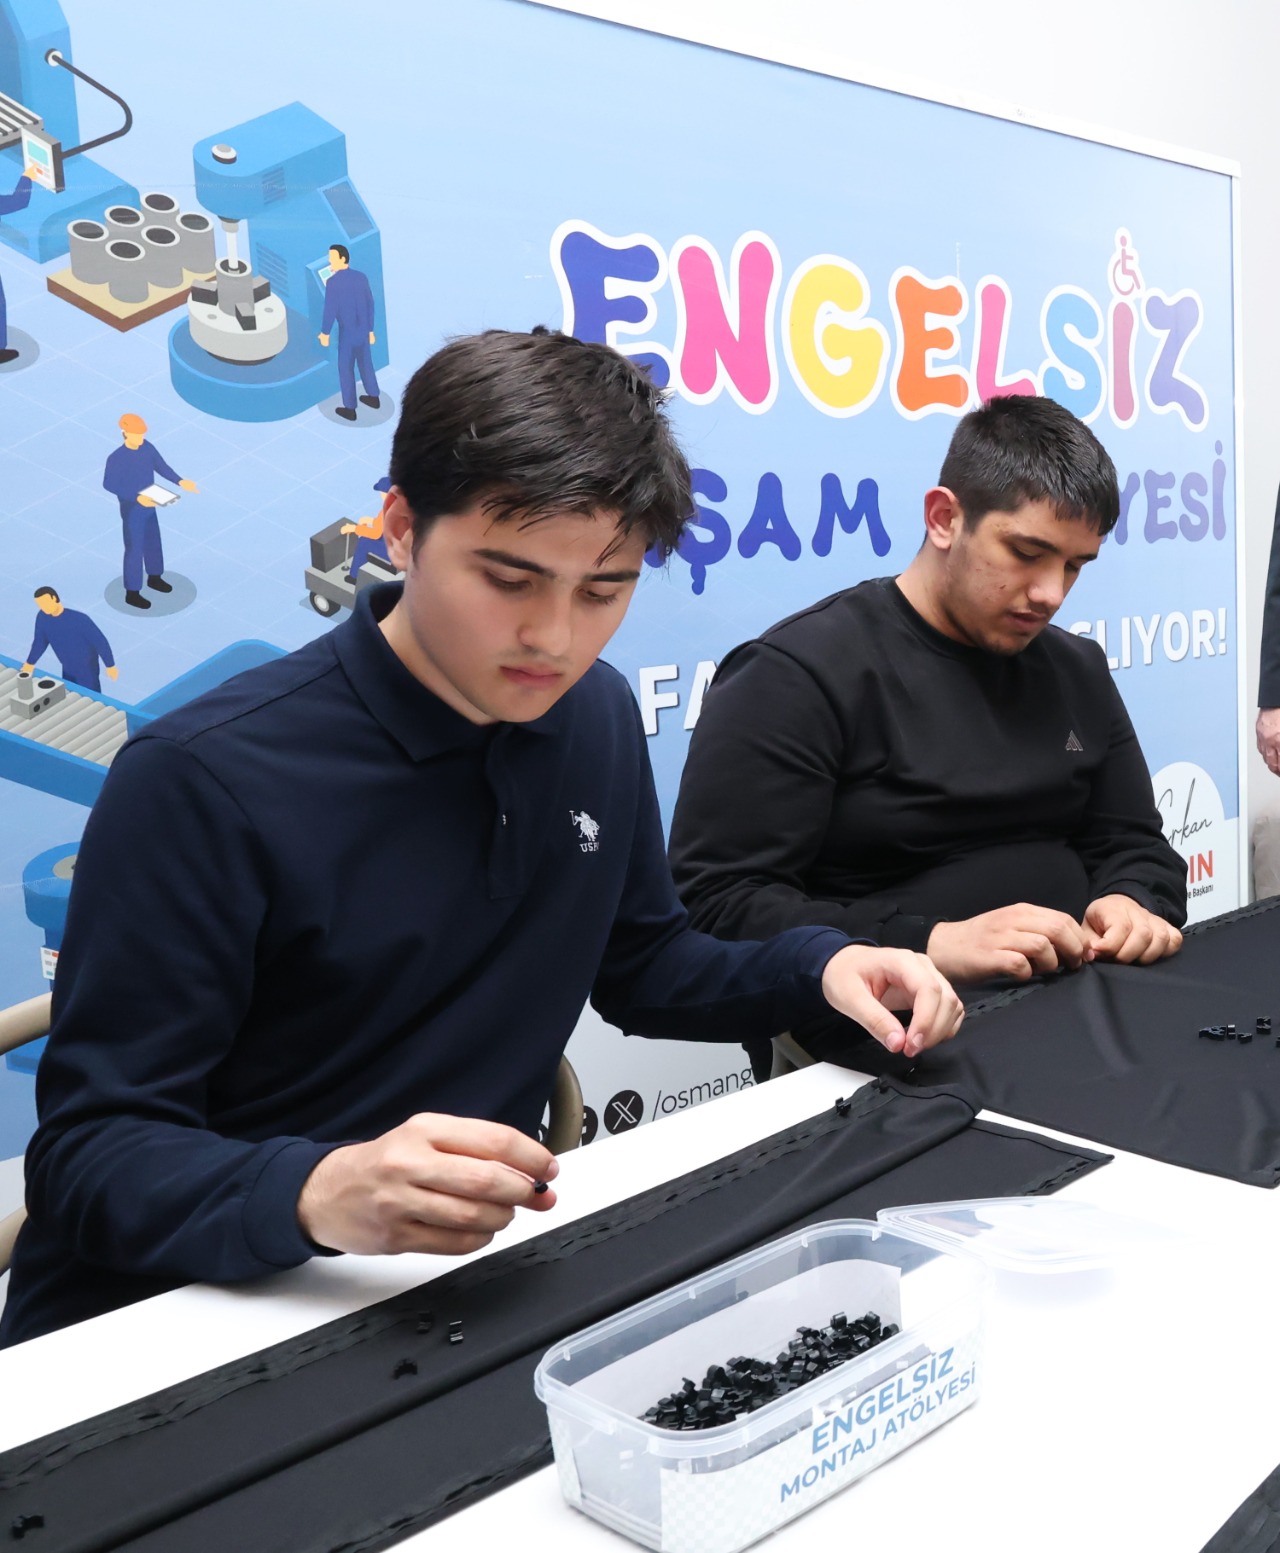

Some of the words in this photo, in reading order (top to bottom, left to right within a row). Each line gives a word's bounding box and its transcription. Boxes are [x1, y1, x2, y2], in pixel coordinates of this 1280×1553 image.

[556, 222, 1208, 429] ENGELSİZ
[643, 468, 892, 595] ŞAM
[1101, 440, 1227, 546] YESİ
[651, 1068, 754, 1122] /osmang
[780, 1435, 877, 1503] MONTAJ
[882, 1360, 977, 1441] ATÖLYESİ
[811, 1347, 954, 1454] ENGELSİZ
